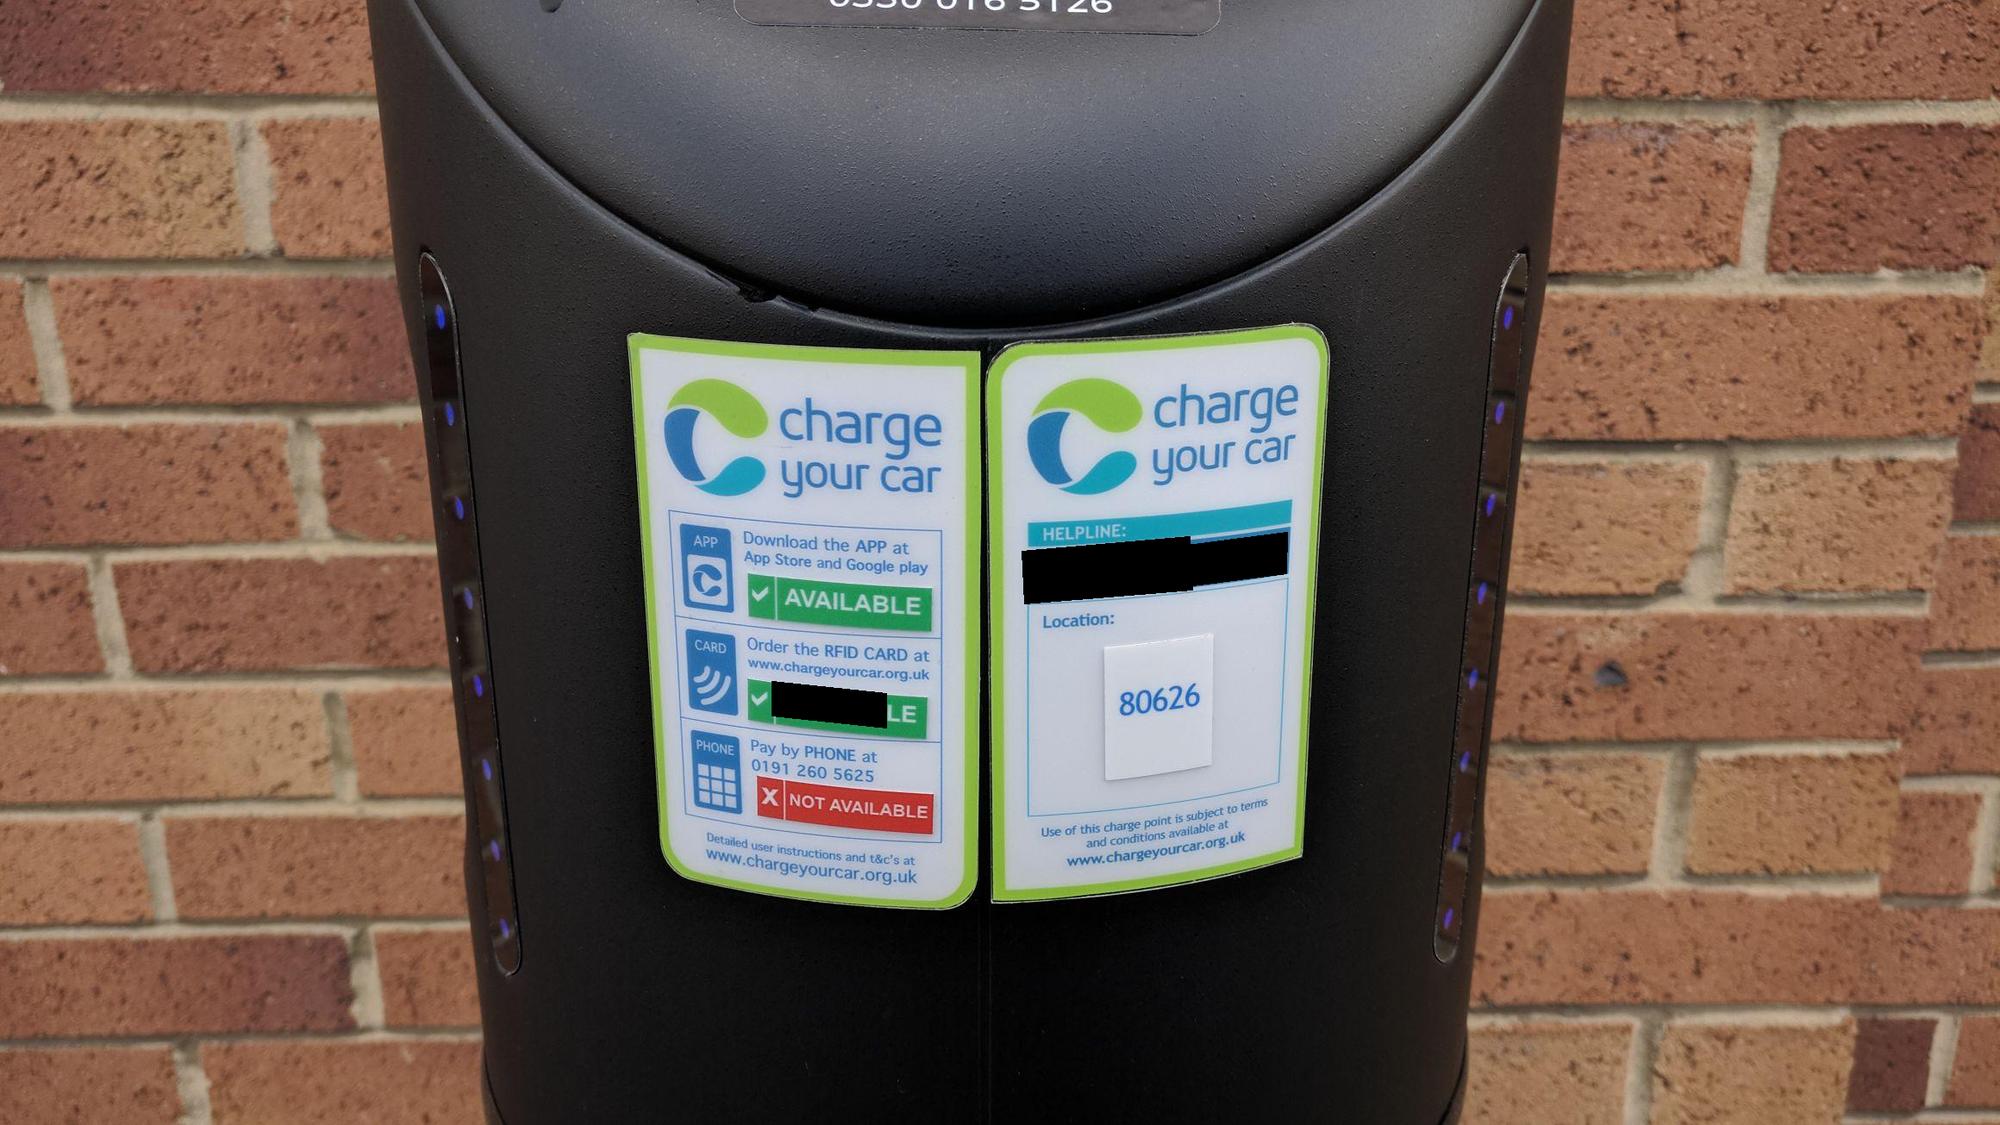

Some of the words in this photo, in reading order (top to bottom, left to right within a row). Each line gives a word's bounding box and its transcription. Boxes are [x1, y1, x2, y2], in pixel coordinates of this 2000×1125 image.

[1153, 383, 1298, 433] charge
[779, 397, 942, 460] charge
[1152, 441, 1236, 485] your
[1244, 434, 1296, 464] car
[780, 459, 868, 497] your
[880, 464, 941, 492] car
[693, 535, 718, 548] APP
[743, 531, 817, 550] Download
[824, 537, 849, 552] the
[855, 540, 887, 553] APP
[892, 542, 909, 554] at
[1042, 523, 1126, 540] HELPLINE:
[744, 551, 770, 565] App
[775, 553, 811, 567] Store
[817, 557, 841, 570] and
[846, 559, 894, 574] Google
[899, 562, 928, 576] play
[784, 588, 921, 615] AVAILABLE
[1042, 613, 1115, 628] Location:
[694, 639, 727, 654] CARD
[747, 637, 787, 654] Order
[794, 642, 819, 657] the
[824, 645, 859, 659] RFID
[863, 647, 907, 662] CARD
[913, 650, 930, 662] at
[748, 657, 930, 681] www.chargeyourcar.org.uk
[1119, 682, 1200, 716] 80626
[695, 739, 735, 756] PHONE
[750, 739, 776, 755] Pay
[781, 744, 798, 758] by
[804, 746, 855, 762] PHONE
[861, 750, 877, 763] at
[751, 758, 790, 775] 0191
[796, 763, 827, 779] 260
[832, 766, 874, 782] 5625
[788, 793, 825, 810] NOT
[829, 799, 928, 819] AVAILABLE
[1041, 825, 1062, 838] Use
[1064, 824, 1077, 836] of
[1079, 822, 1101, 835] this
[1103, 818, 1141, 835] charge
[1143, 814, 1172, 831] point
[1175, 811, 1184, 824] is
[1186, 806, 1224, 822] subject
[1227, 803, 1238, 815] to
[1240, 797, 1269, 811] terms
[1085, 836, 1107, 849] and
[1109, 829, 1166, 847] conditions
[1168, 821, 1216, 839] available
[1217, 819, 1229, 831] at
[706, 831, 748, 849] Detailed
[751, 842, 773, 852] user
[776, 845, 842, 861] instructions
[845, 851, 866, 863] and
[903, 855, 915, 866] at
[1066, 830, 1246, 867] www.chargeyourcar.org.uk
[706, 848, 918, 885] www.chargeyourcar.org.uk
